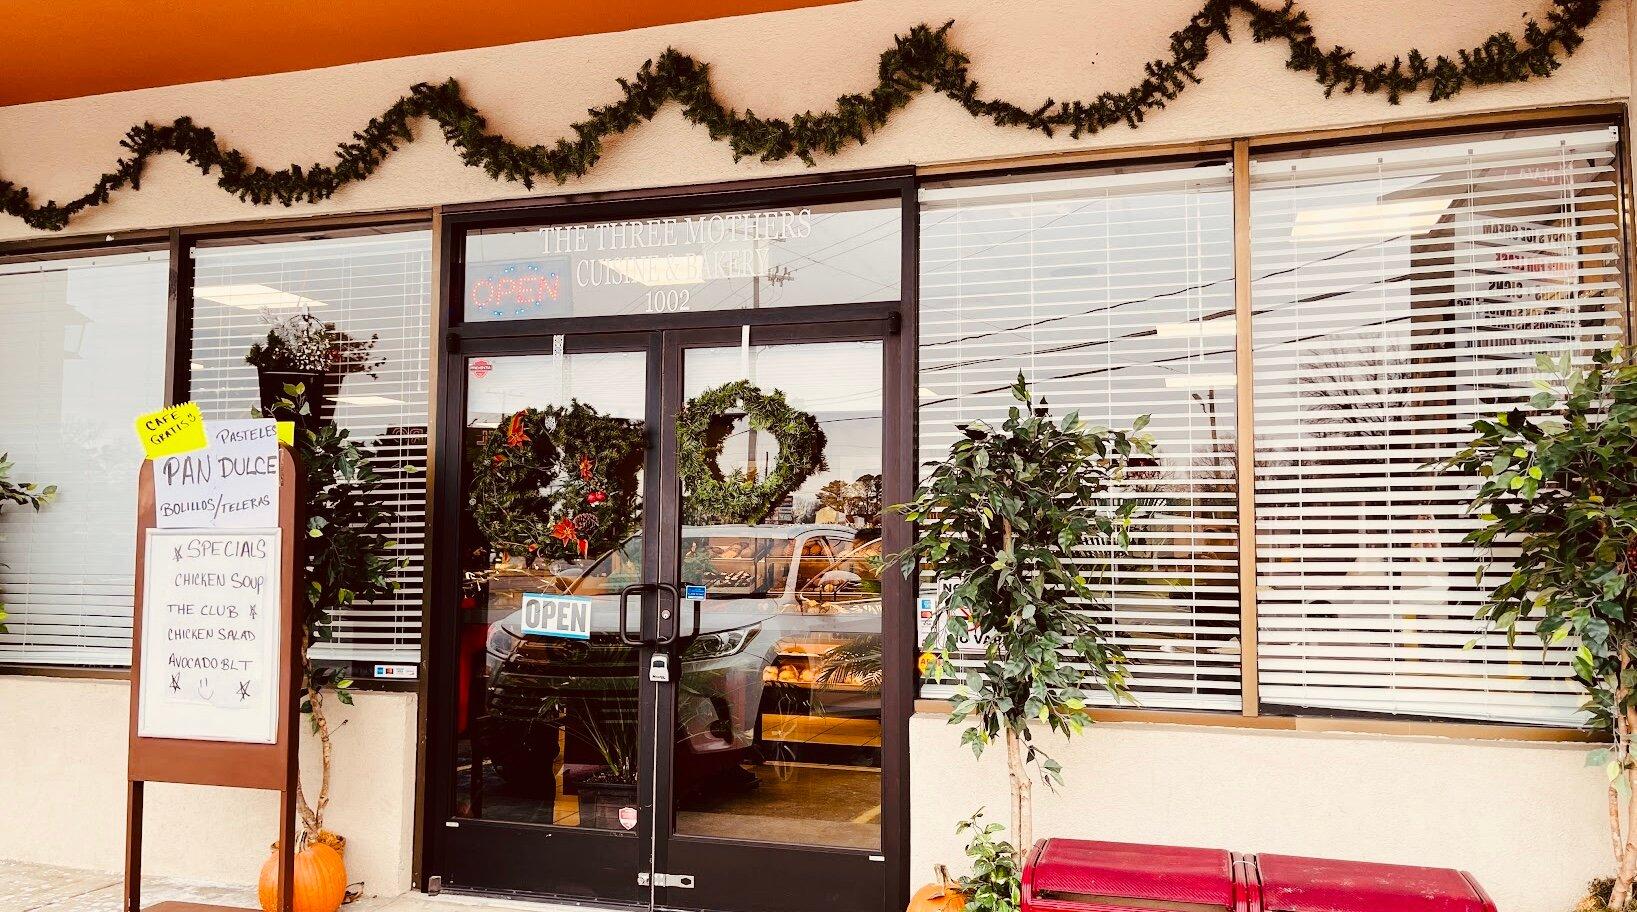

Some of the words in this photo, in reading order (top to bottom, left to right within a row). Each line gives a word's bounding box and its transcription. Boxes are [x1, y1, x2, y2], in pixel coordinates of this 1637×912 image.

[540, 225, 589, 254] THE
[593, 218, 678, 250] THREE
[684, 208, 811, 245] MOTHERS
[576, 255, 660, 287] CUISINE
[686, 247, 769, 281] BAKERY
[472, 275, 560, 307] OPEN
[645, 289, 690, 313] 1002
[145, 411, 180, 431] CAFE
[150, 420, 190, 445] GRATIS
[216, 425, 277, 444] PASTELES
[163, 454, 211, 485] PAN
[218, 456, 277, 478] DULCE
[187, 538, 266, 559] SPECIALS
[174, 573, 225, 588] CHICKEN
[231, 572, 264, 594] SOUP
[168, 604, 194, 615] THE
[200, 604, 239, 619] CLUB
[525, 599, 587, 633] OPEN
[168, 628, 214, 641] CHICKEN
[218, 628, 256, 641] SALAD
[168, 653, 218, 670] AVOCADO
[220, 658, 254, 671] BLT
